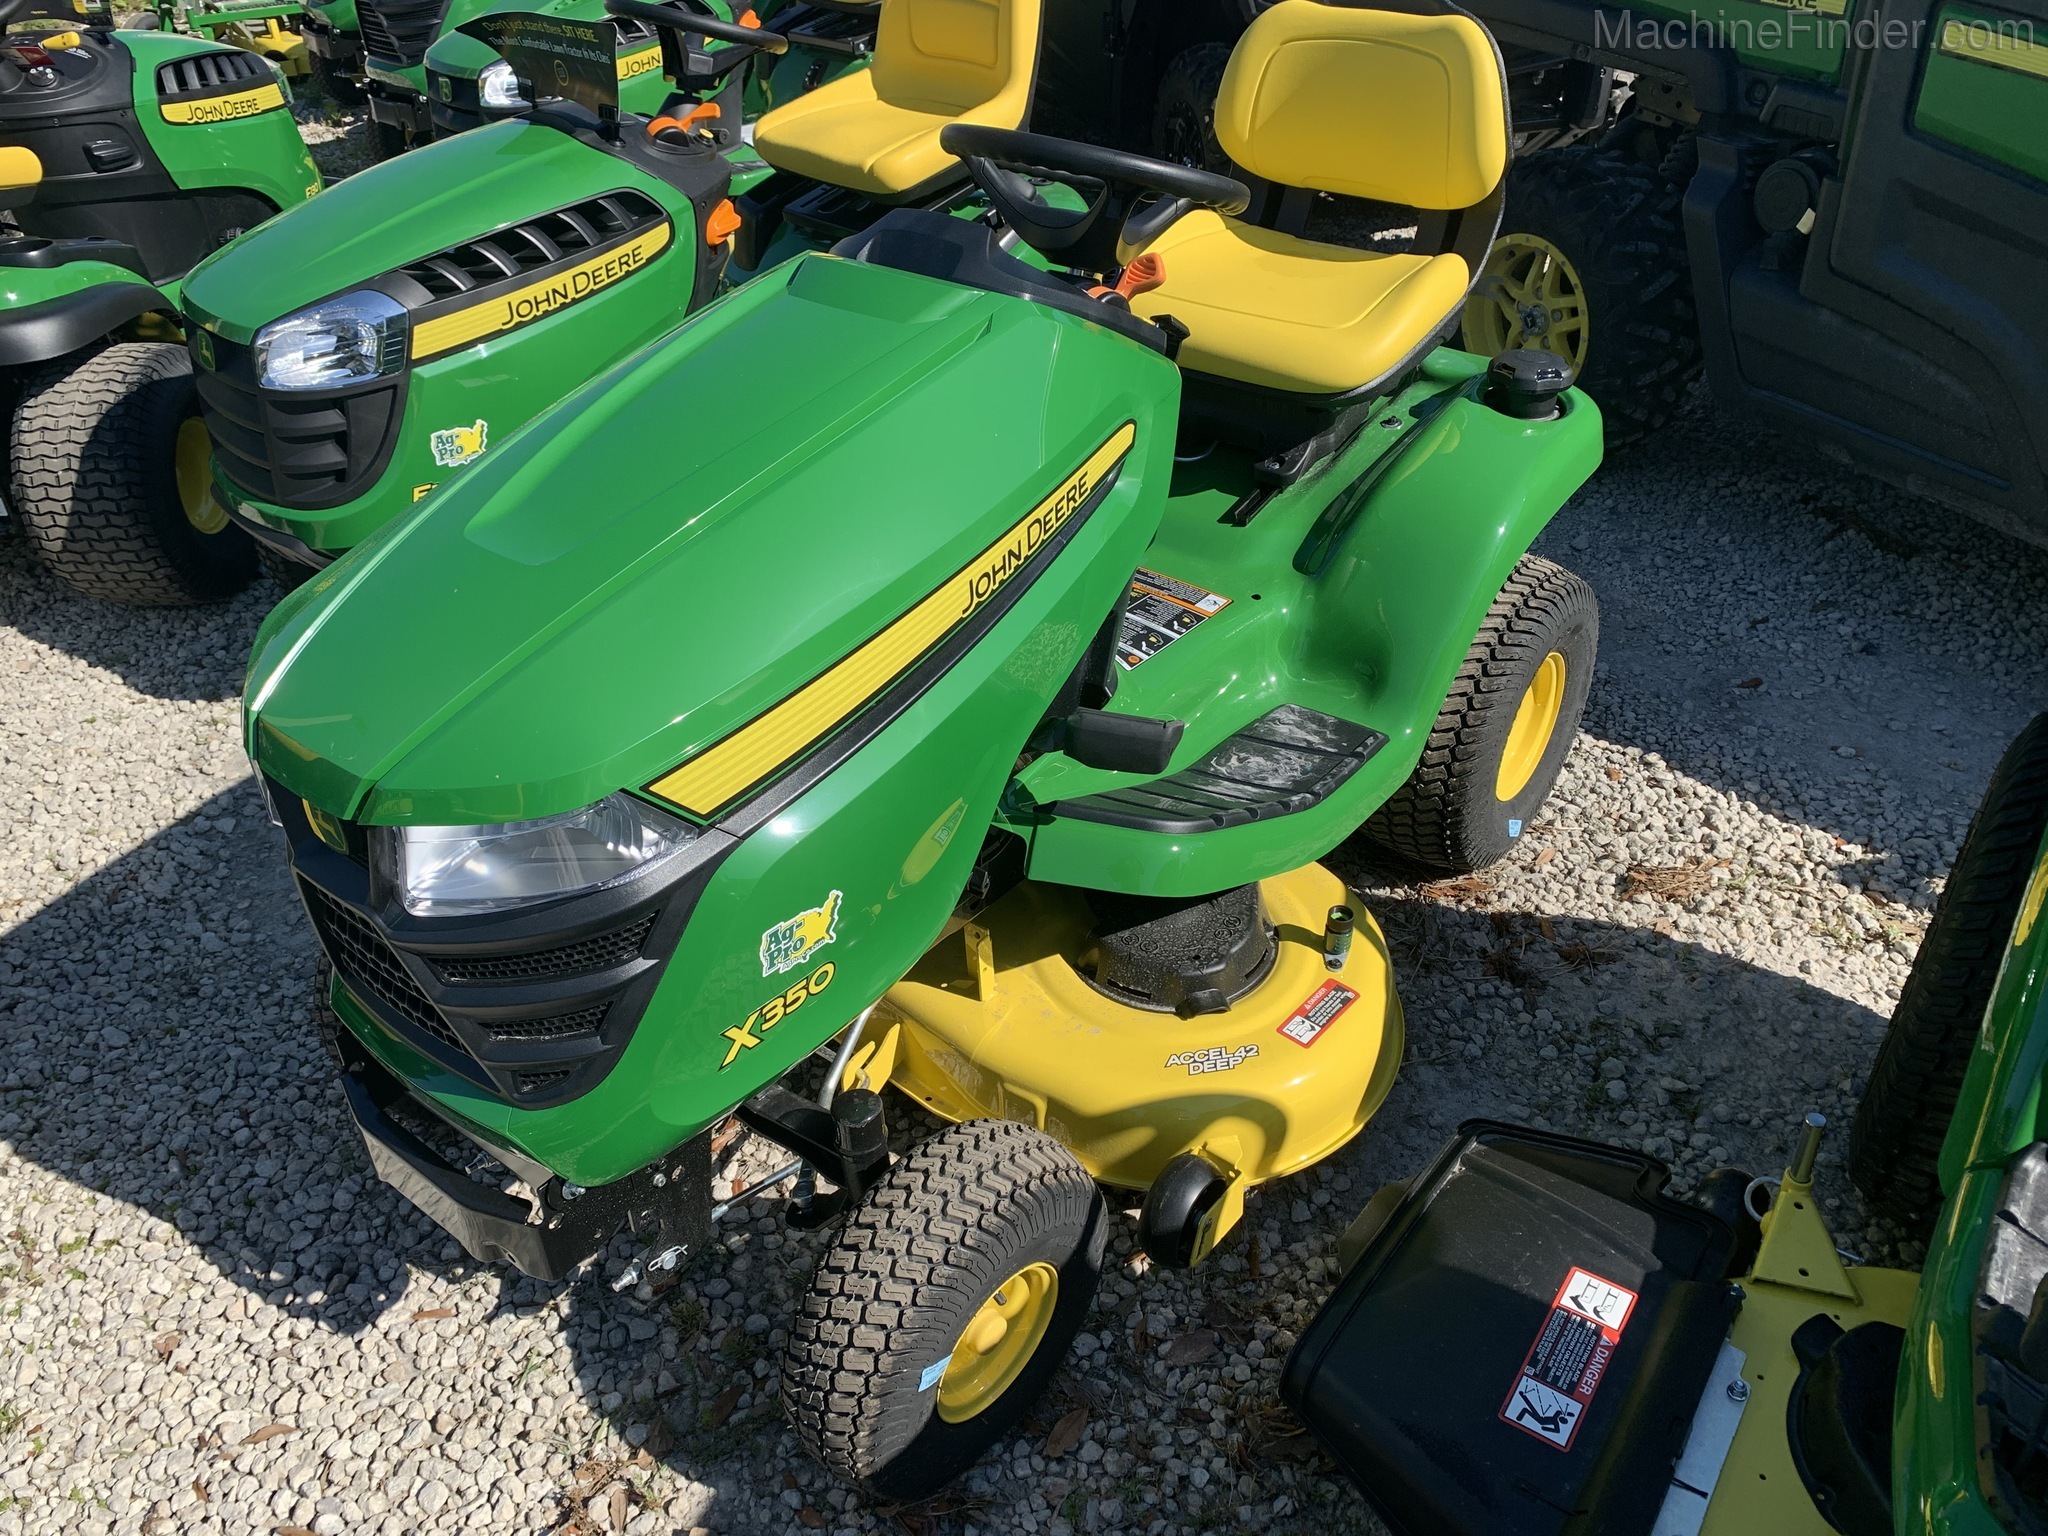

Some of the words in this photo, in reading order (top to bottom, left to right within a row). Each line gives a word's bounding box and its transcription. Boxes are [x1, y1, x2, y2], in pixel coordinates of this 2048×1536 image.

[621, 53, 661, 77] JOHN
[187, 104, 223, 121] JOHN
[225, 98, 260, 117] DEERE
[501, 283, 569, 326] JOHN
[572, 245, 644, 295] DEERE
[436, 434, 459, 449] Ag-
[438, 446, 464, 461] Pro
[962, 540, 1022, 615] JOHN
[1027, 470, 1089, 550] DEERE
[766, 920, 804, 953] Ag-
[766, 937, 805, 971] Pro
[1307, 987, 1327, 1006] DANGER
[718, 961, 836, 1071] X350
[1189, 1057, 1242, 1075] DEEP
[1568, 1327, 1582, 1350] THROWN
[1581, 1335, 1597, 1363] ROTATING
[1555, 1350, 1571, 1376] OBJECTS
[1572, 1363, 1584, 1382] BLADE
[1578, 1347, 1609, 1396] DANGER
